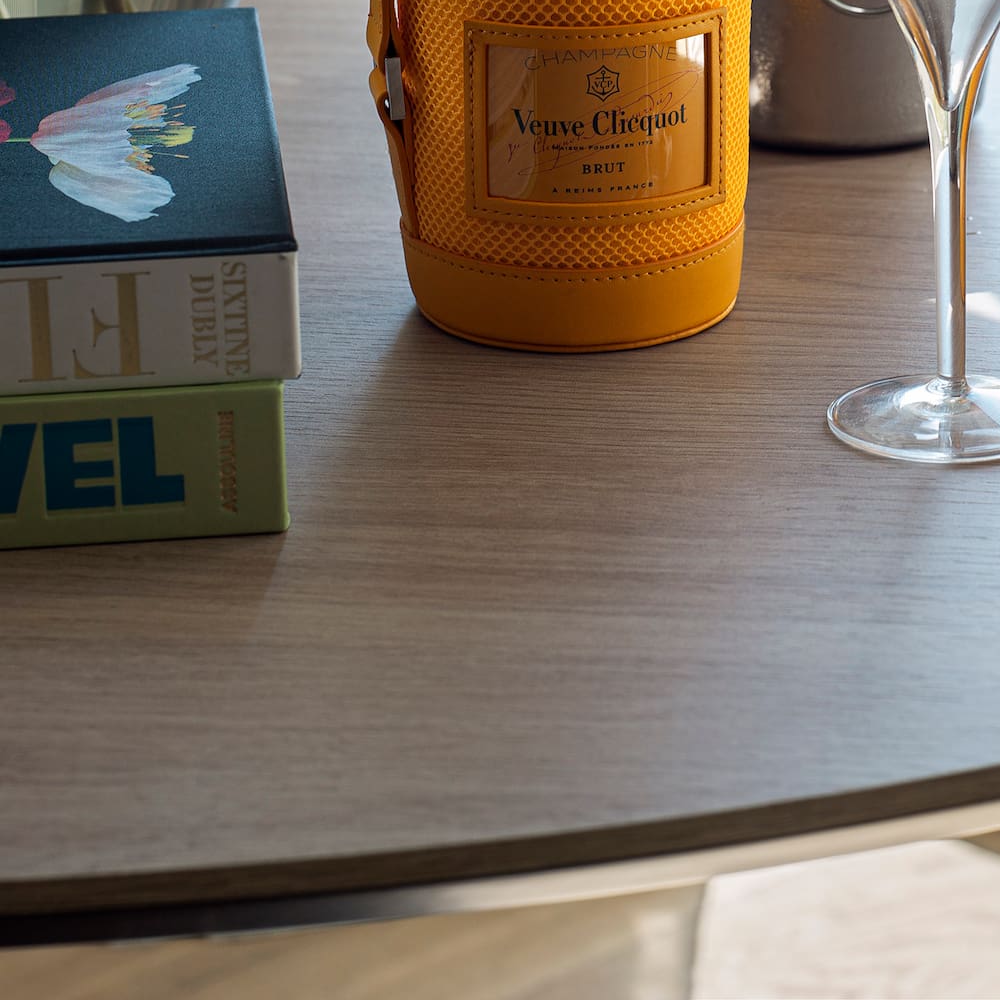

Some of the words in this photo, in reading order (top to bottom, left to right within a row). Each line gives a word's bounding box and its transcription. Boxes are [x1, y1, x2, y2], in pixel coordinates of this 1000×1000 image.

[524, 45, 677, 71] CHAMPAGNE
[510, 108, 585, 137] Veuve
[592, 103, 688, 137] Clicquot
[582, 161, 625, 175] BRUT
[610, 182, 654, 192] FRANCE
[188, 273, 218, 368] DUBLY
[221, 261, 250, 377] SIXTINE
